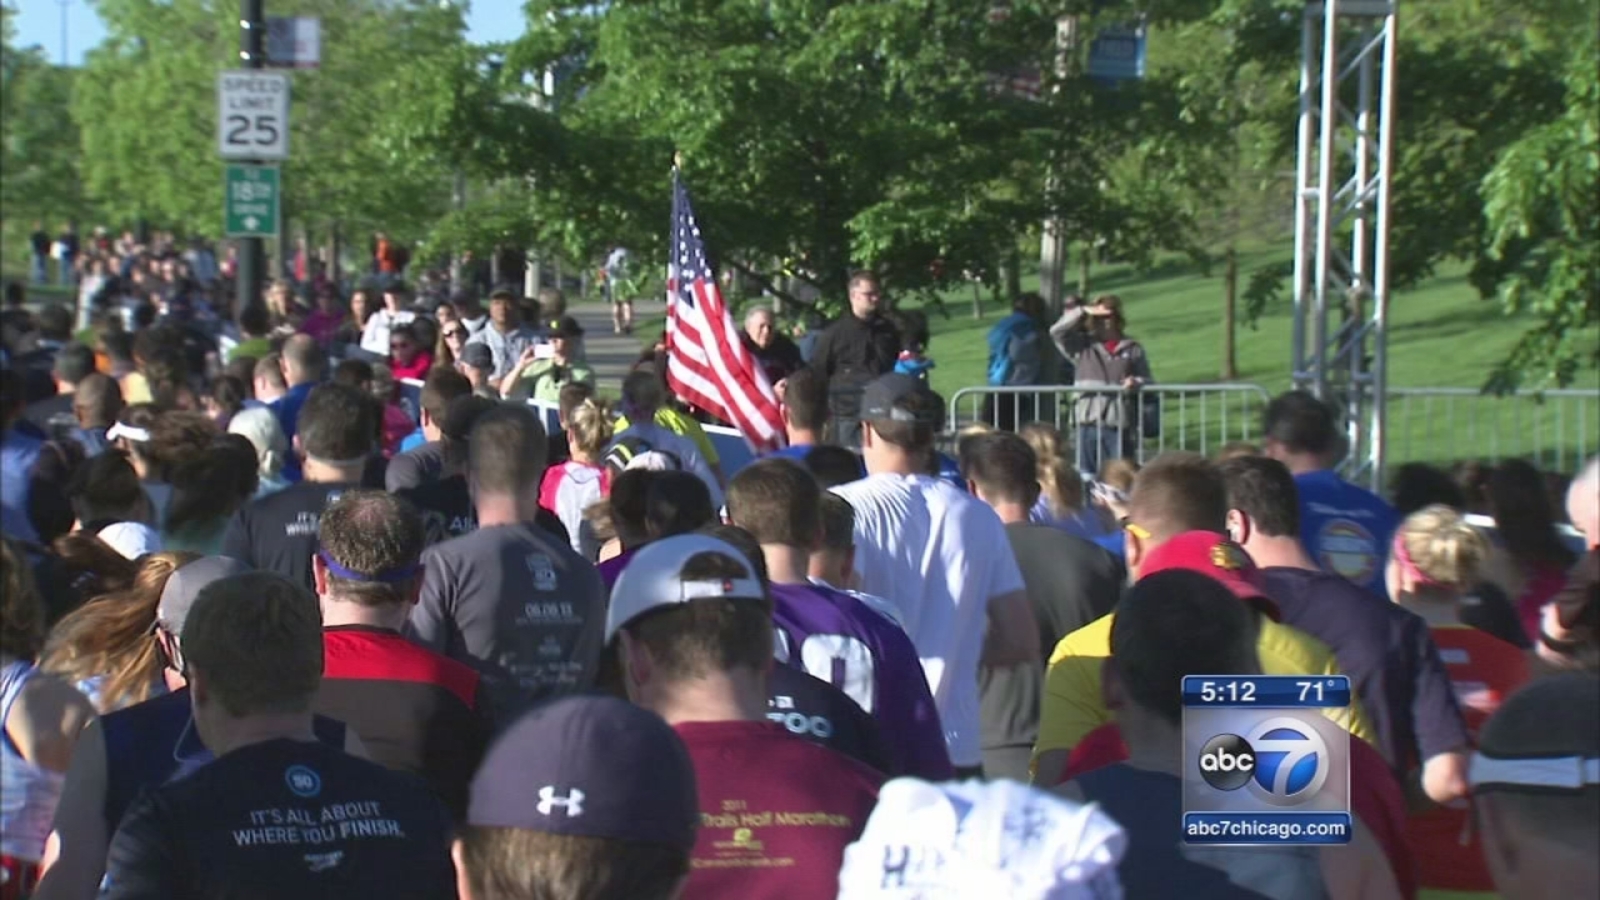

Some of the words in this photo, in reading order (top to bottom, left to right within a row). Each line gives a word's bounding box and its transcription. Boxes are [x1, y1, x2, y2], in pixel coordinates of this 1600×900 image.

[224, 77, 284, 94] SPEED
[229, 96, 275, 110] LIMIT
[226, 113, 279, 147] 25
[251, 809, 283, 826] IT'S
[286, 809, 317, 826] ALL
[320, 801, 380, 823] ABOUT
[740, 811, 772, 827] Half
[774, 811, 851, 827] Marathon
[233, 825, 300, 846] WHERE
[301, 824, 336, 845] YOU
